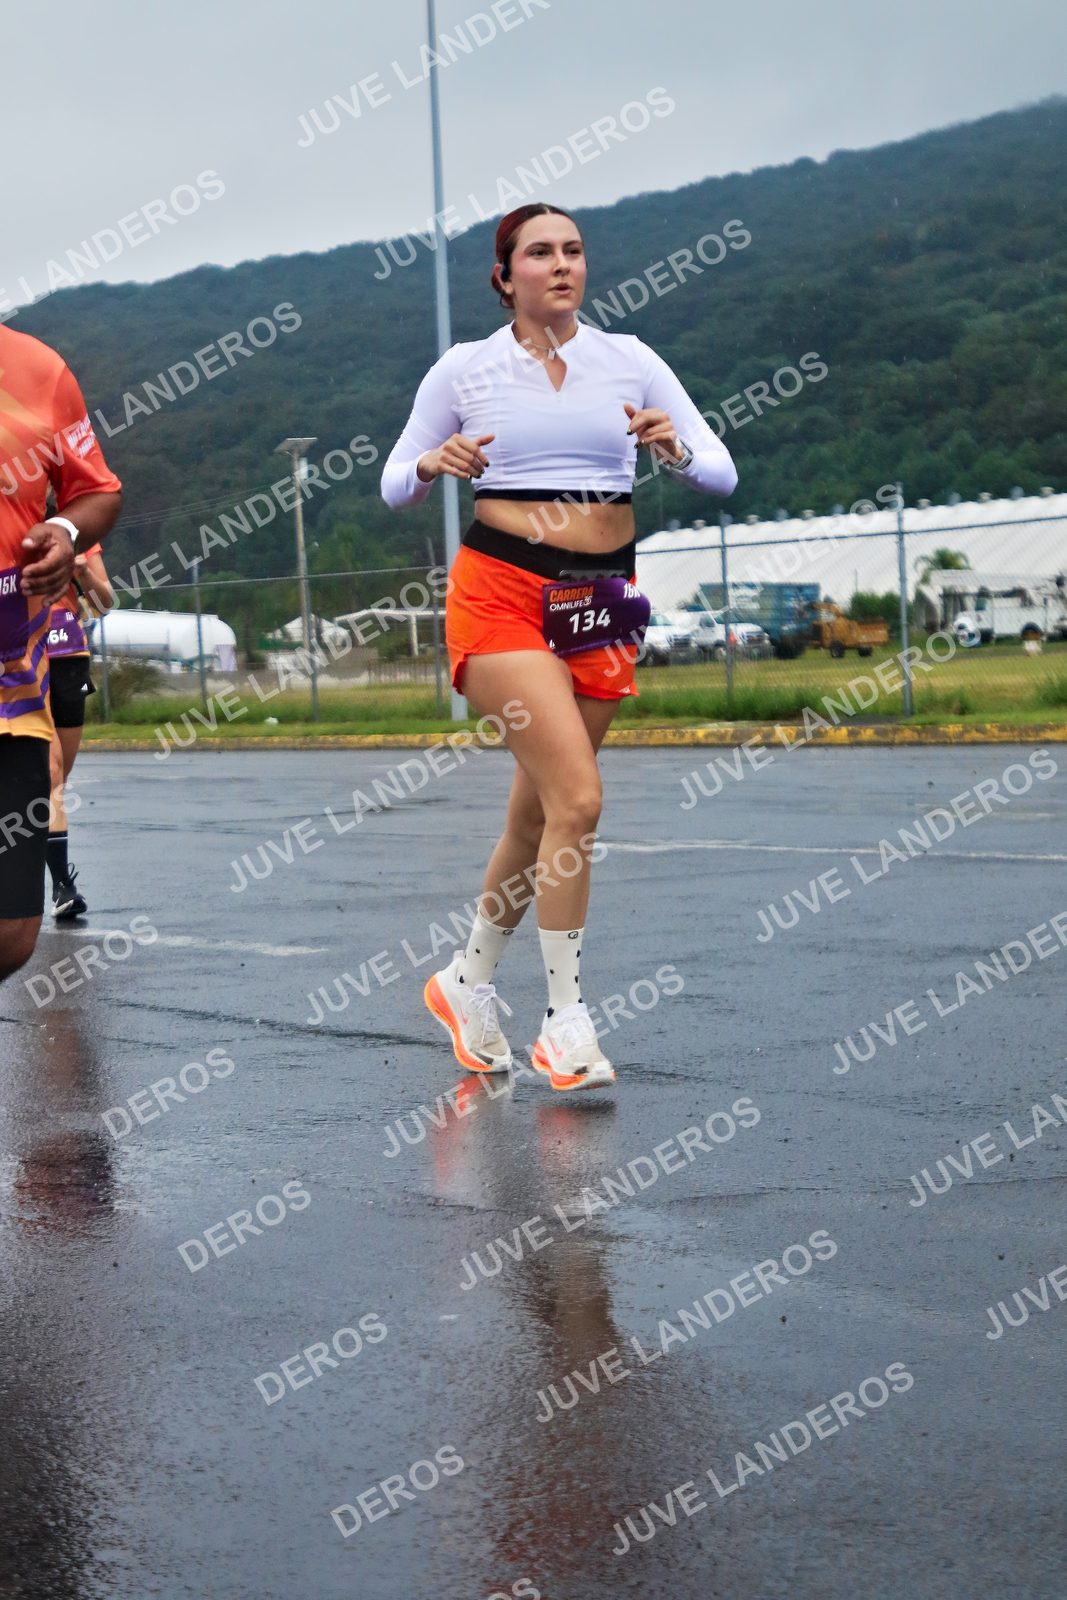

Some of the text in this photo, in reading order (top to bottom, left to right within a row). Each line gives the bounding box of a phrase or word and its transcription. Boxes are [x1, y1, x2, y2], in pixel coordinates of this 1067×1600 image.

[550, 586, 594, 603] CARRERA
[550, 600, 584, 611] OMNILIFE
[569, 608, 611, 634] 134
[47, 628, 68, 645] 64
